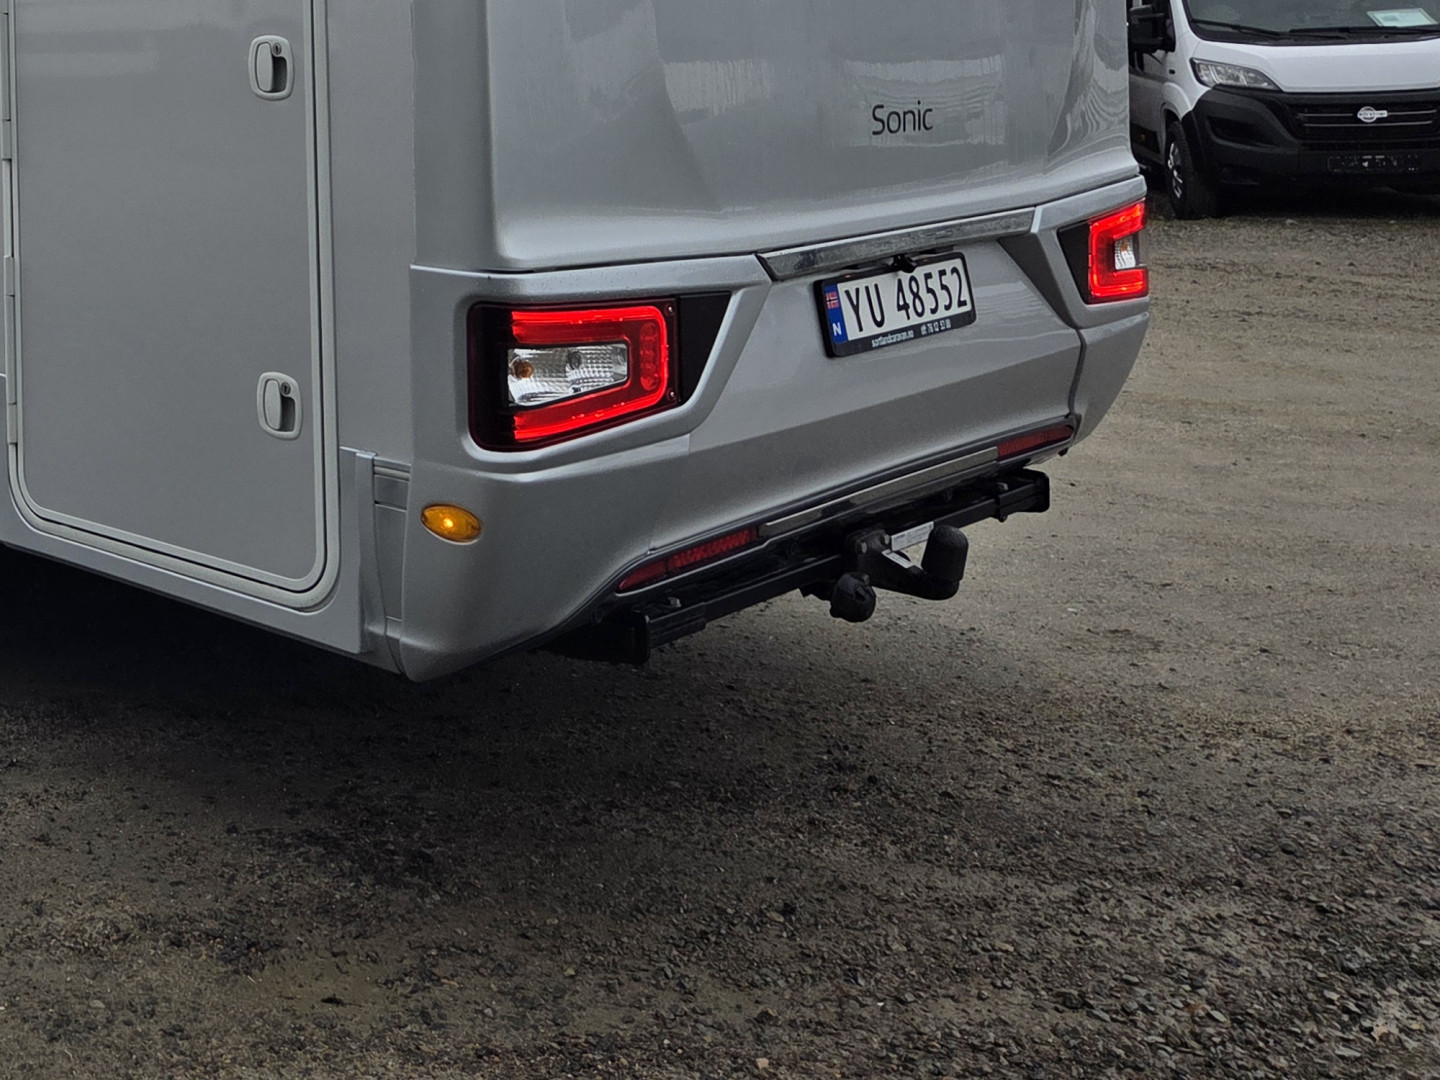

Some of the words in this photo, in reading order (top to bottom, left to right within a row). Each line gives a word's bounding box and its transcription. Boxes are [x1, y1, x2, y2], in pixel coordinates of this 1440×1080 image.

[872, 100, 933, 136] Sonic
[844, 282, 887, 332] YU
[896, 266, 968, 321] 48552
[832, 322, 842, 336] N
